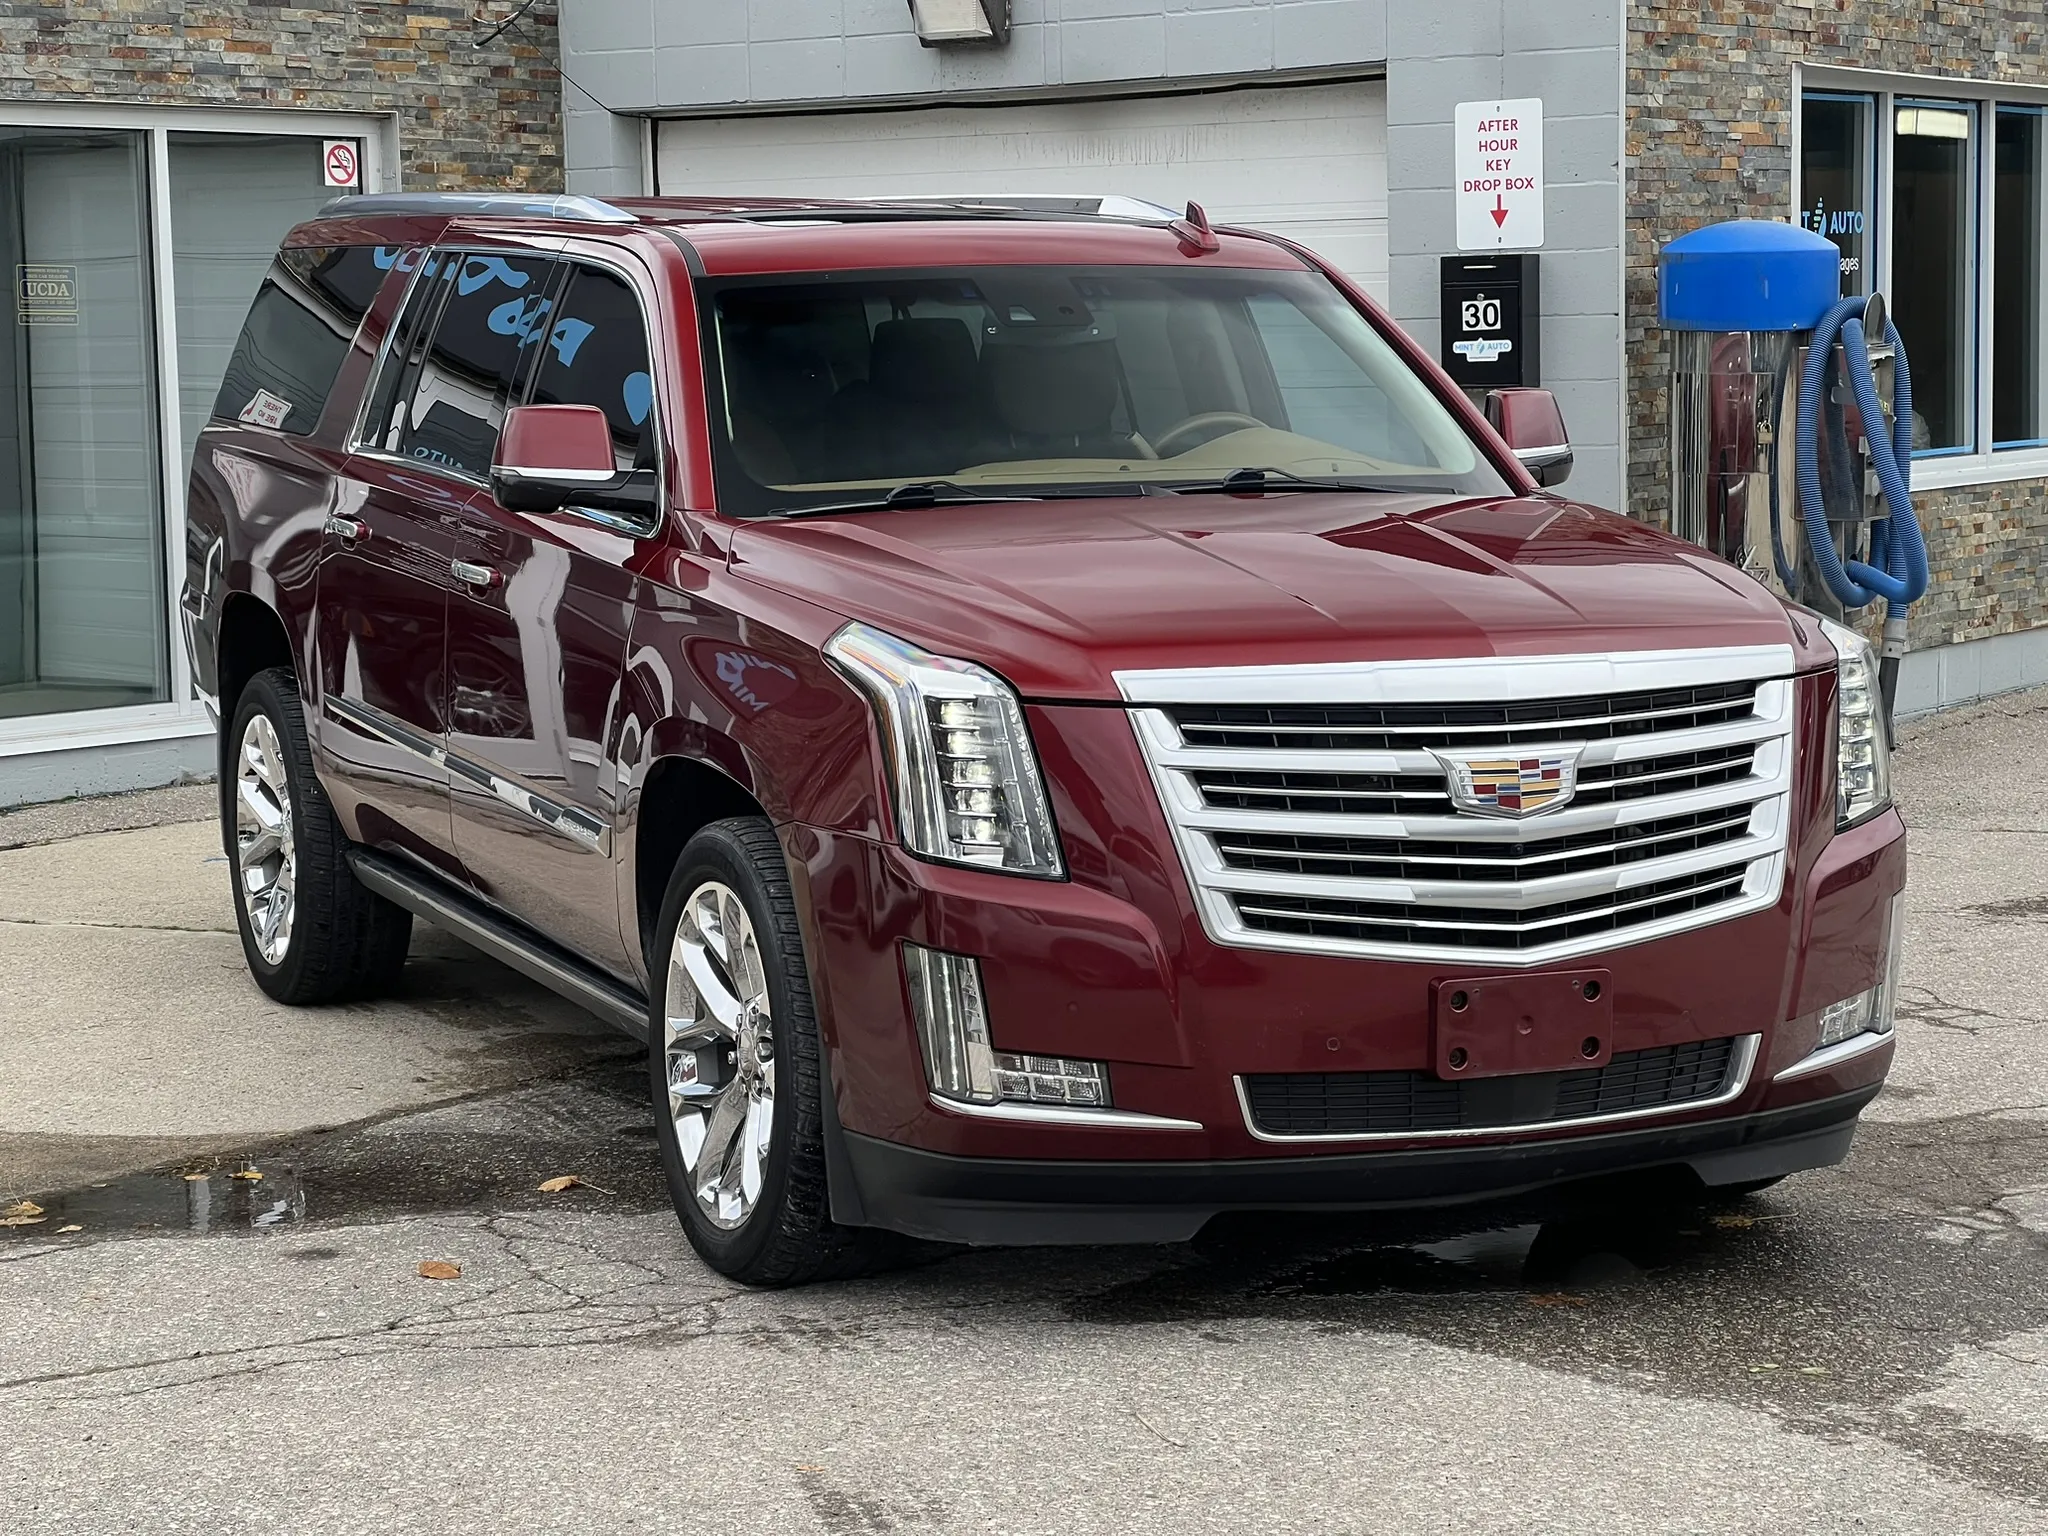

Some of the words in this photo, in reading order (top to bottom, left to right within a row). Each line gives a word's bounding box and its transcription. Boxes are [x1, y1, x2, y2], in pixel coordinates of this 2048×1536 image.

[1477, 118, 1518, 133] AFTER
[1478, 138, 1518, 152] HOUR
[1486, 158, 1511, 171] KEY
[1463, 179, 1501, 192] DROP
[1505, 177, 1534, 190] BOX
[1830, 211, 1864, 233] AUTO
[26, 282, 70, 297] UCDA
[1464, 302, 1499, 329] 30
[1454, 343, 1475, 352] MINT
[1487, 342, 1510, 351] AUTO
